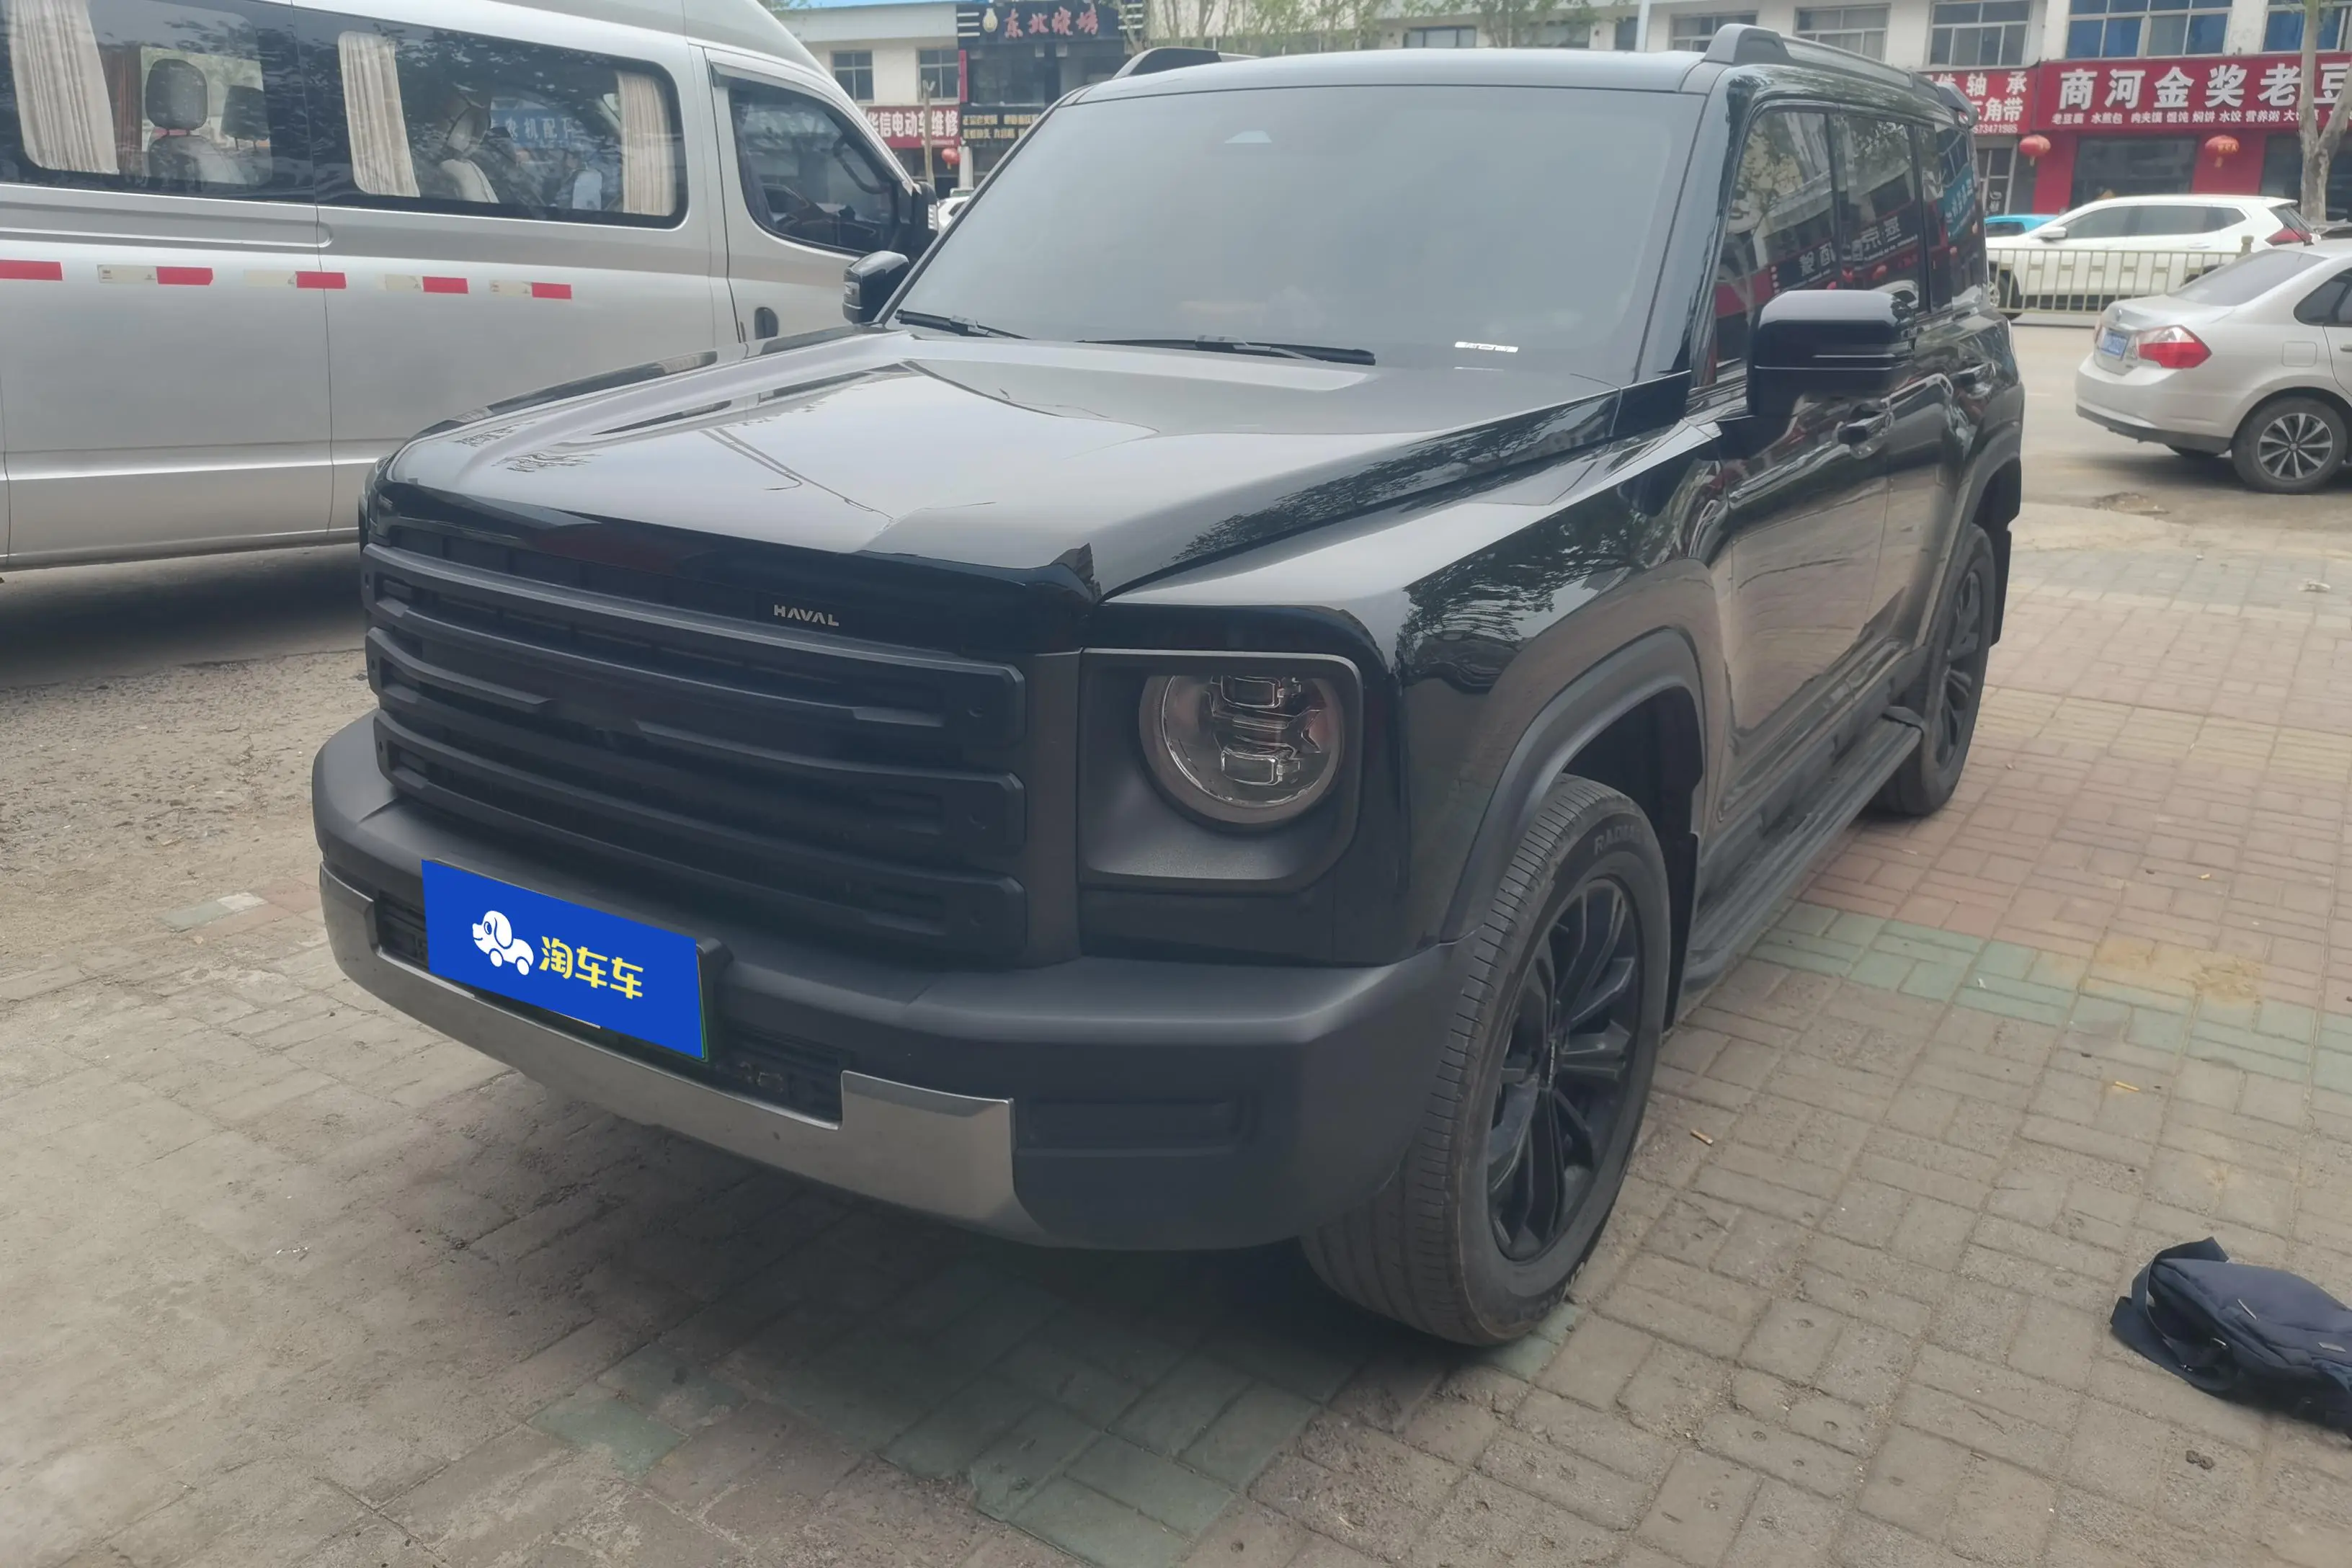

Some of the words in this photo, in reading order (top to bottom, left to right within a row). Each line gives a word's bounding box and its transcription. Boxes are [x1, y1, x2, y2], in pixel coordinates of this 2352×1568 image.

[2059, 63, 2351, 110] 商河金奖老豆
[2219, 110, 2242, 122] 水饺
[773, 604, 839, 626] HAVAL
